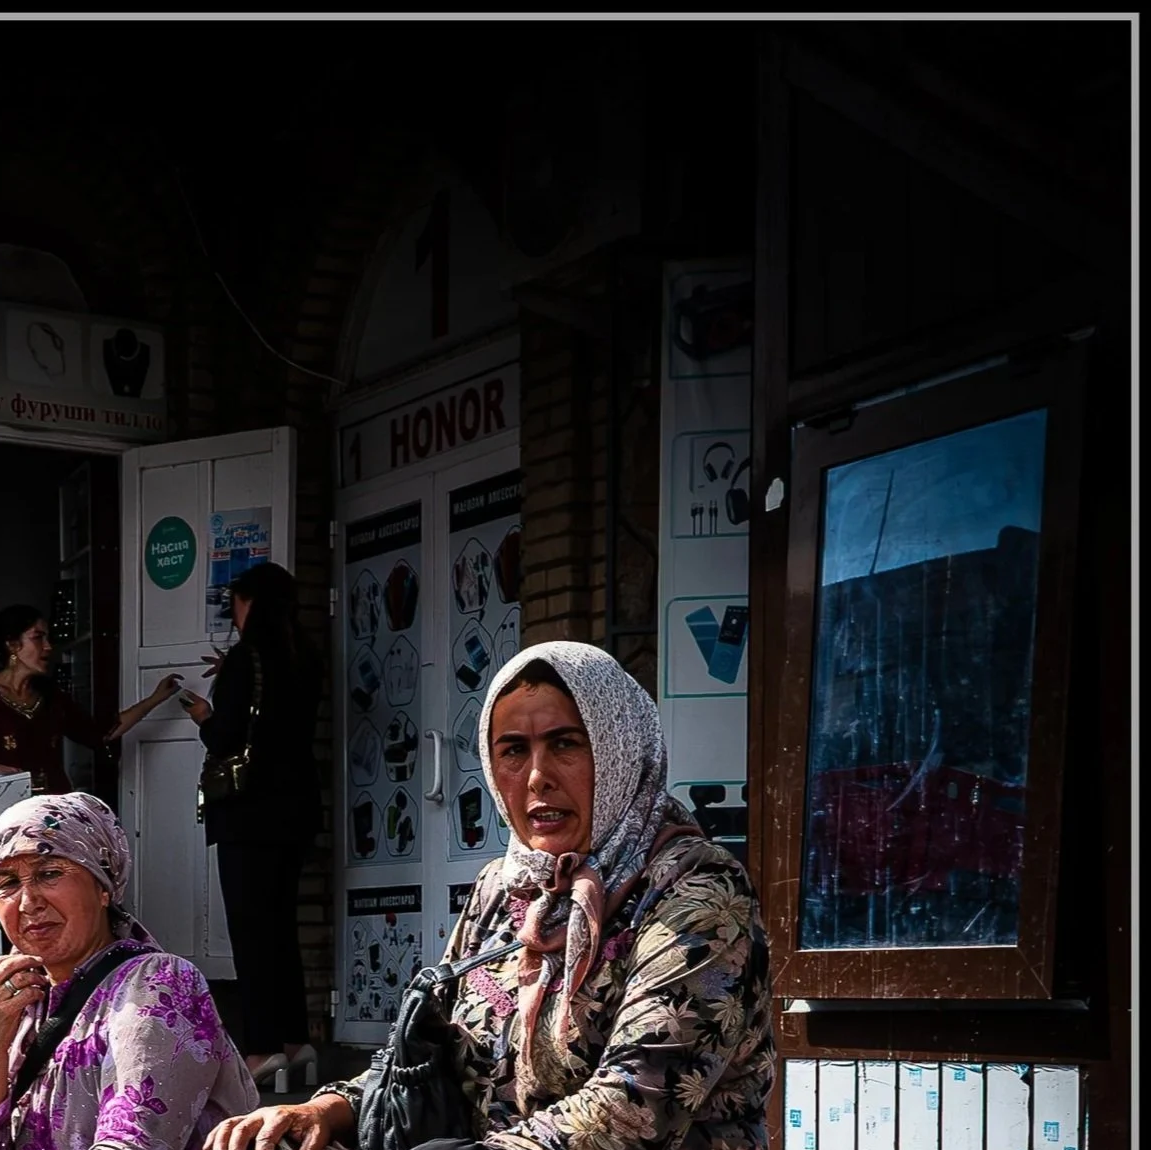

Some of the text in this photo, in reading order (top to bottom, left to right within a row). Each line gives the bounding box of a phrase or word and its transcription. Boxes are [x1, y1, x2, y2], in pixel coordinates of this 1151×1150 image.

[11, 393, 95, 422] фуруши
[349, 378, 506, 481] 1 HONOR
[151, 539, 189, 555] Насия
